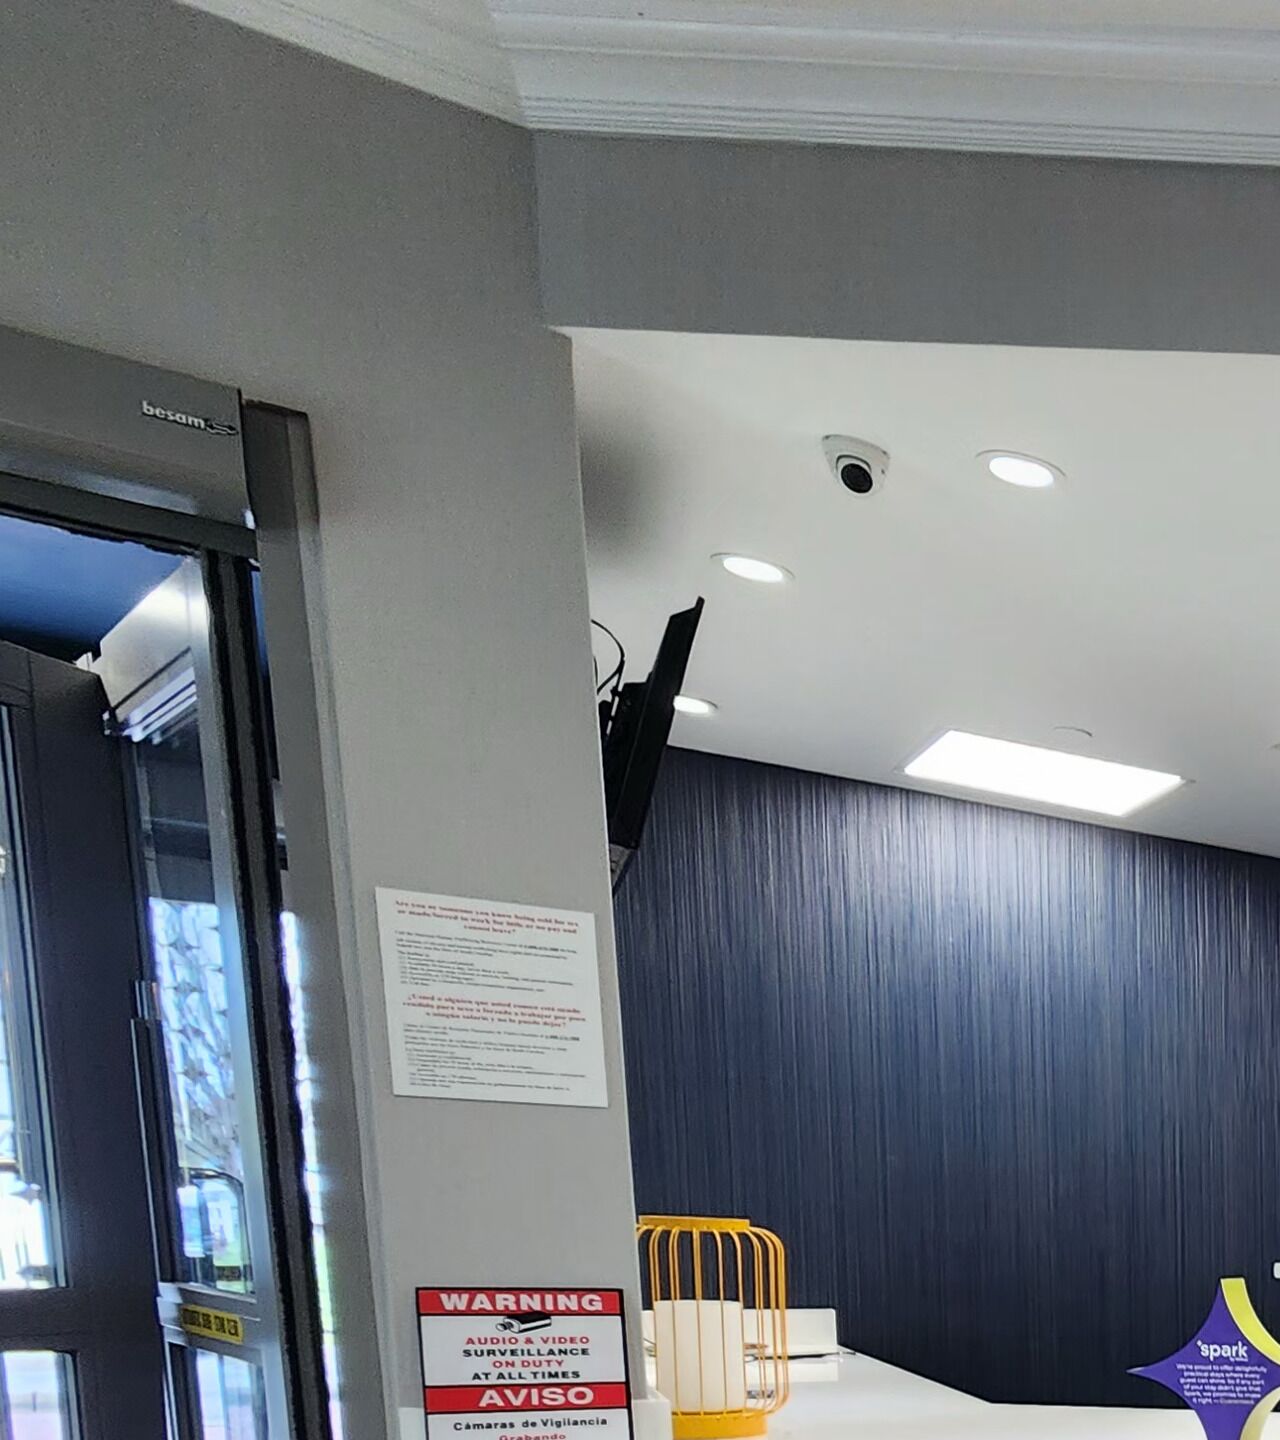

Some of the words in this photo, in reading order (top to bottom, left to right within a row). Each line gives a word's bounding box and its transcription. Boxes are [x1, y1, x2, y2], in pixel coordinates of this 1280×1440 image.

[142, 401, 205, 429] besam
[439, 1293, 603, 1312] WARNING
[465, 1336, 519, 1345] AUDIO
[524, 1336, 534, 1345] &
[540, 1336, 590, 1345] VIDEO
[462, 1347, 590, 1358] SURVEILLANCE
[1201, 1341, 1248, 1361] spark
[492, 1360, 515, 1369] ON
[521, 1359, 564, 1368] DUTY
[472, 1372, 491, 1381] AT
[496, 1371, 526, 1380] ALL
[530, 1370, 580, 1380] TIMES
[478, 1387, 594, 1407] AVISO
[522, 1419, 537, 1428] de
[541, 1417, 608, 1429] Vigilancia
